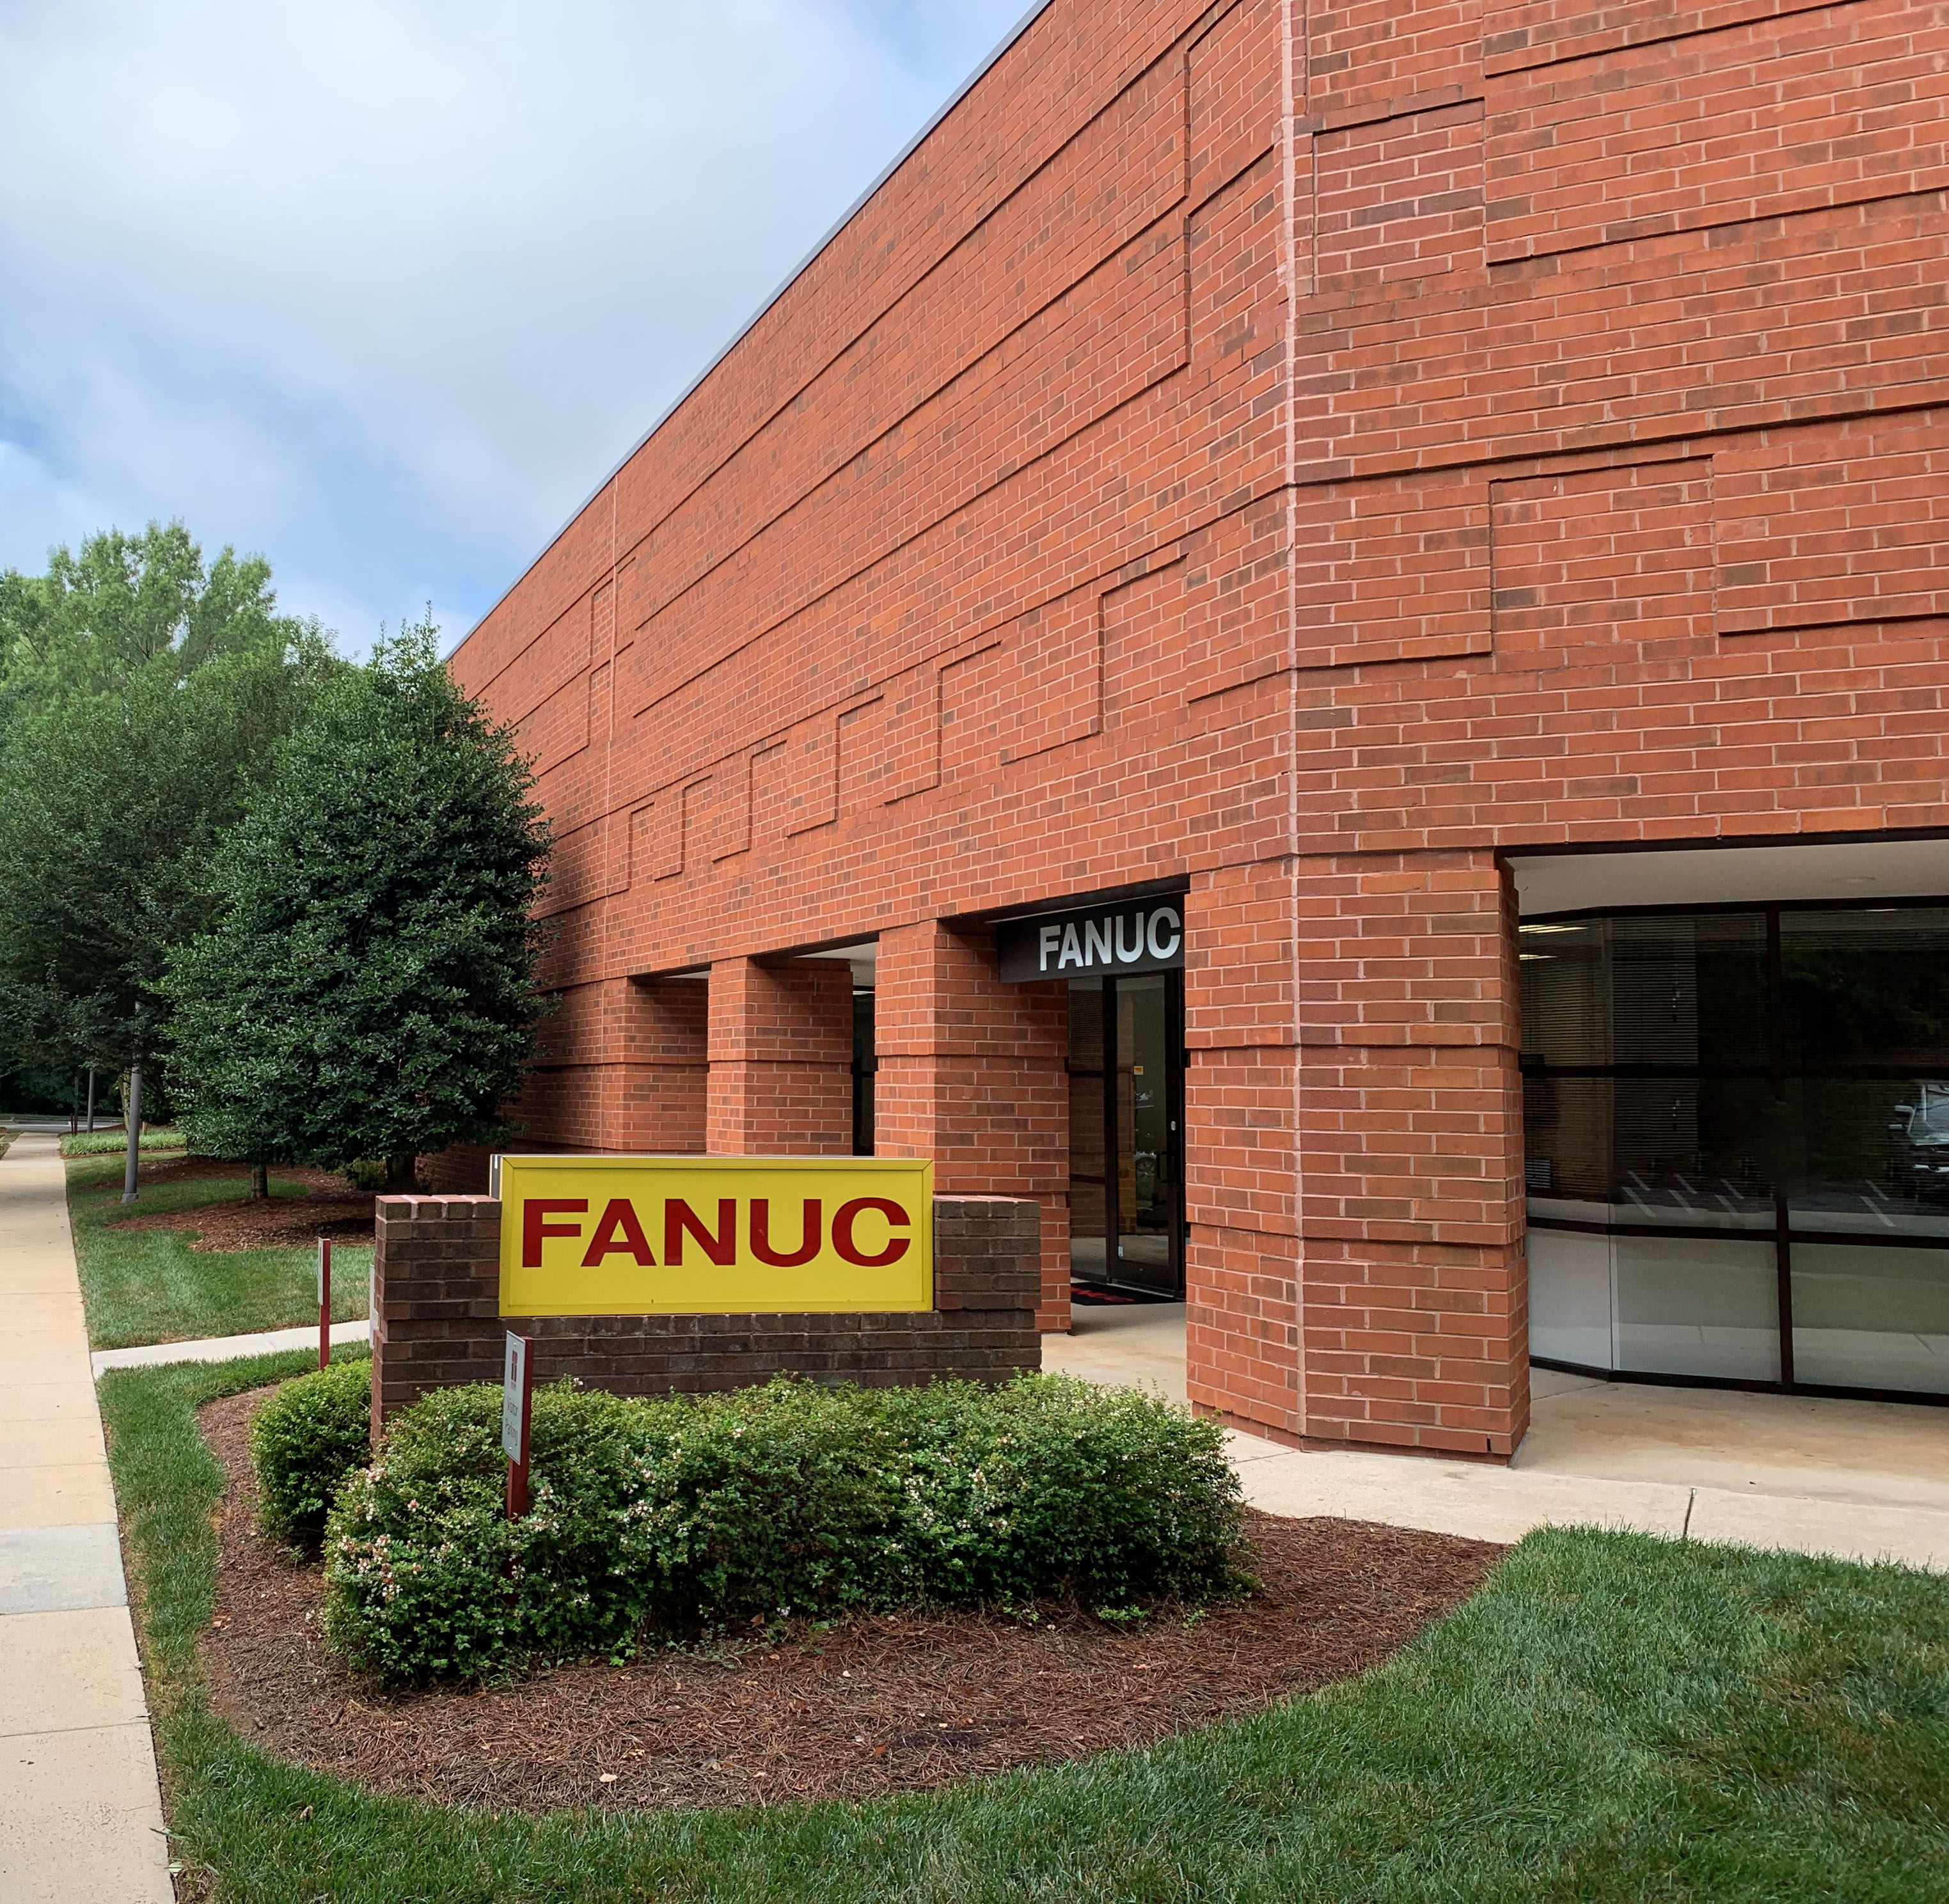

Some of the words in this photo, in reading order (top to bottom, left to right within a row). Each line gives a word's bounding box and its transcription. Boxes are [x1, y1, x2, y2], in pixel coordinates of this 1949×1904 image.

[1039, 907, 1181, 971] FANUC
[522, 1197, 911, 1268] FANUC
[507, 1396, 518, 1417] Visitor
[505, 1418, 518, 1446] Parking
